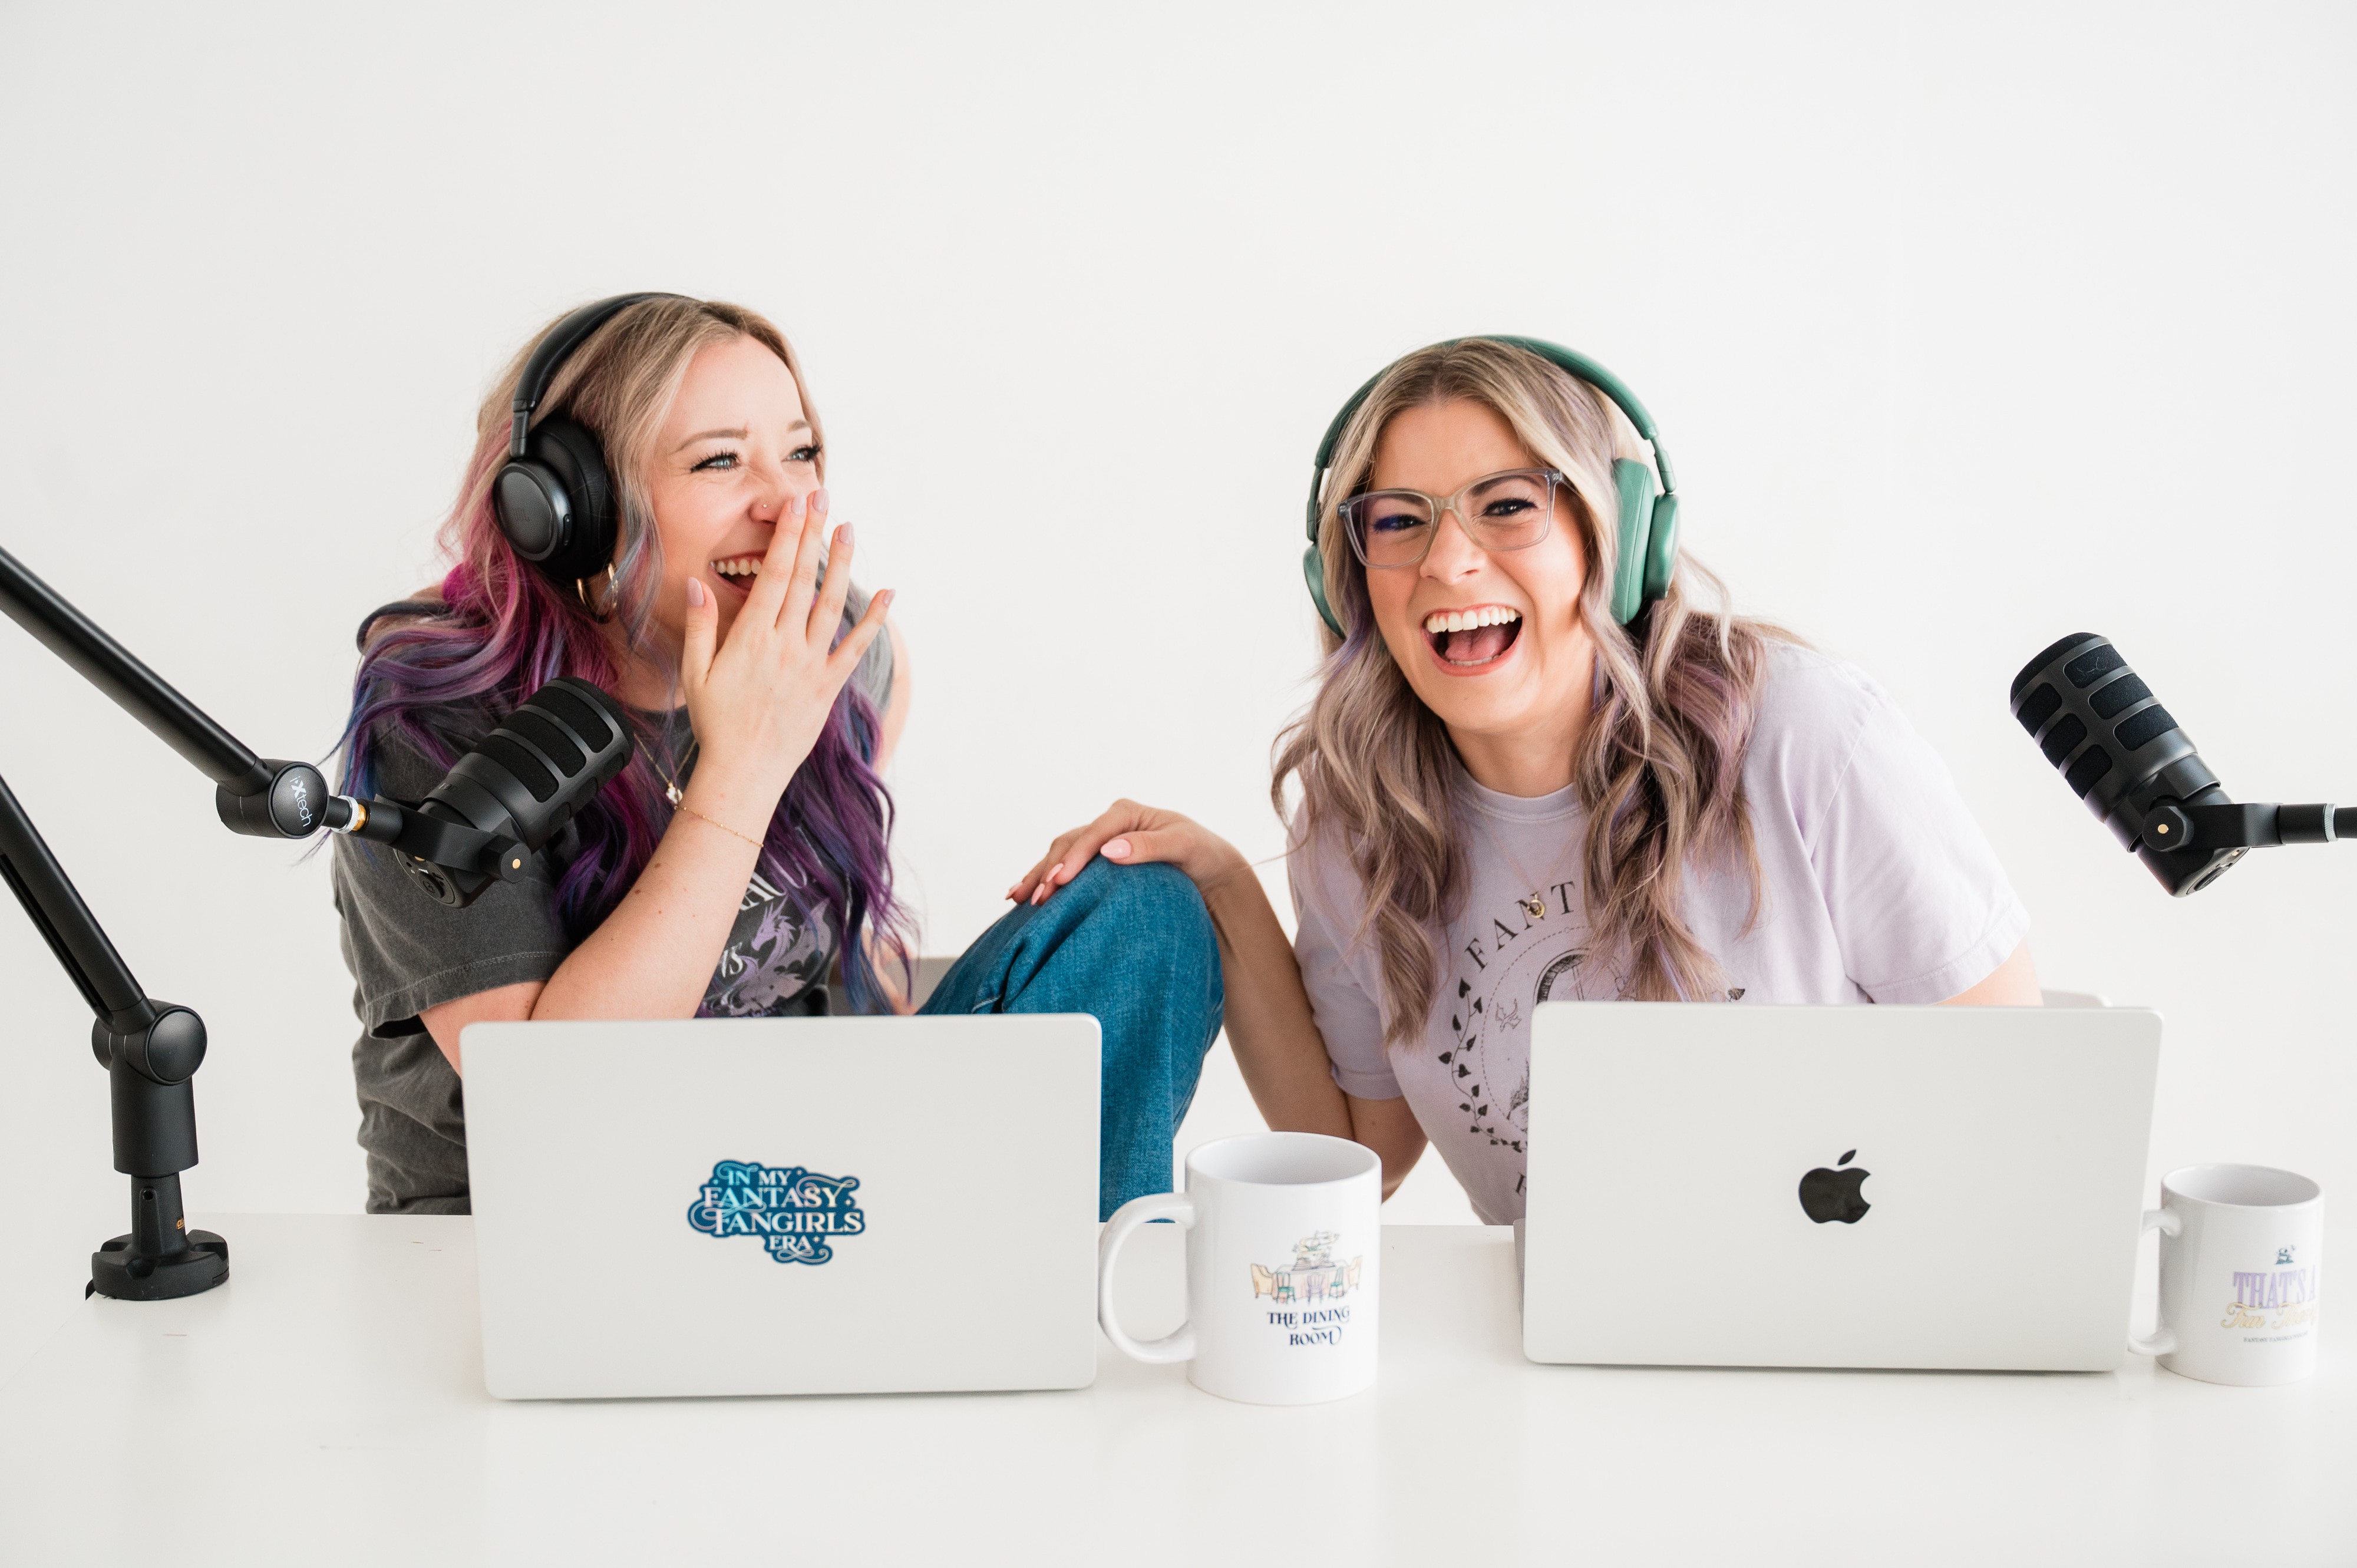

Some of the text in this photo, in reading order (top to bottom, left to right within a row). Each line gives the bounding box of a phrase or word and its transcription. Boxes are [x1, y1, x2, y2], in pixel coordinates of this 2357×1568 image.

[1465, 881, 1576, 972] FANT
[704, 1176, 857, 1208] FANTASY
[758, 1170, 791, 1186] MY
[691, 1200, 863, 1235] FANGIRLS
[2232, 1268, 2306, 1309] THAT'S
[1267, 1306, 1350, 1329] THE DINING
[1289, 1325, 1342, 1346] ROOM
